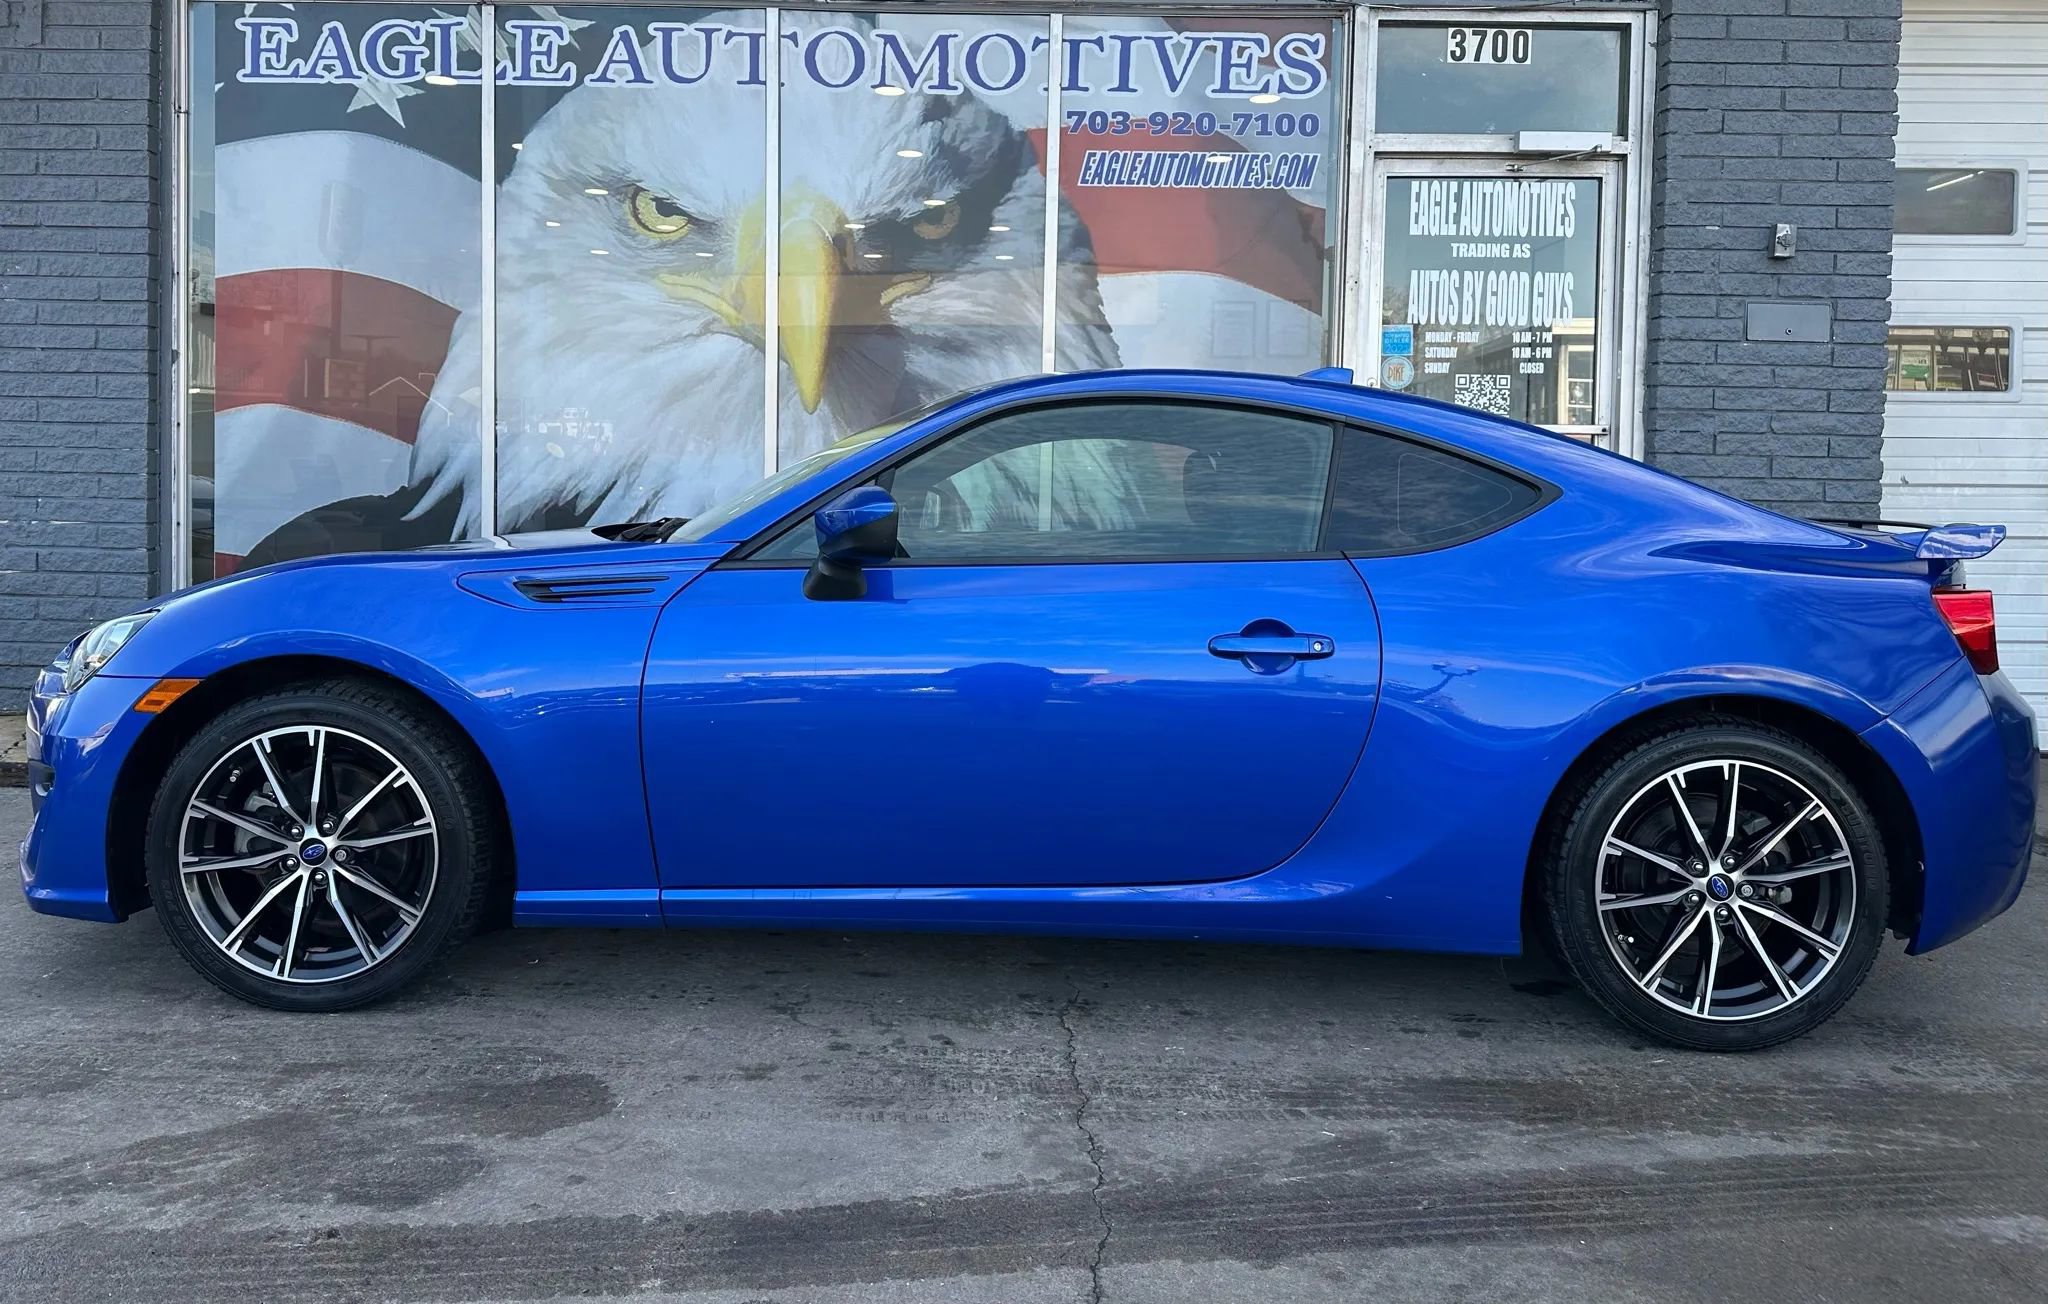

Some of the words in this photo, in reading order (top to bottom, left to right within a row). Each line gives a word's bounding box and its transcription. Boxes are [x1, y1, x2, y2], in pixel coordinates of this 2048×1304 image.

[236, 17, 577, 85] EAGLE
[590, 23, 1326, 98] AUTOMOTIVES
[1450, 28, 1529, 64] 3700
[1066, 110, 1320, 137] 703-920-7100
[1078, 150, 1319, 189] EAGLEAUTOMOTIVES.COM
[1409, 180, 1458, 236] EAGLE
[1459, 181, 1576, 238] AUTOMOTIVES
[1451, 243, 1510, 258] TRADING
[1512, 243, 1531, 258] AS
[1407, 269, 1460, 326] AUTOS
[1462, 270, 1484, 325] BY
[1486, 270, 1529, 326] GOOD
[1532, 271, 1574, 327] GUYS
[1424, 347, 1458, 358] SATURDAY
[1512, 347, 1520, 358] 10
[1521, 347, 1532, 358] AM
[1542, 347, 1552, 358] PM
[1425, 331, 1453, 343] MONDAY
[1457, 331, 1480, 343] FRIDAY
[1512, 332, 1520, 343] 10
[1521, 332, 1532, 343] AM
[1536, 332, 1540, 343] 7
[1542, 332, 1553, 343] PM
[1424, 362, 1451, 373] SUNDAY
[1520, 362, 1544, 374] CLOSED
